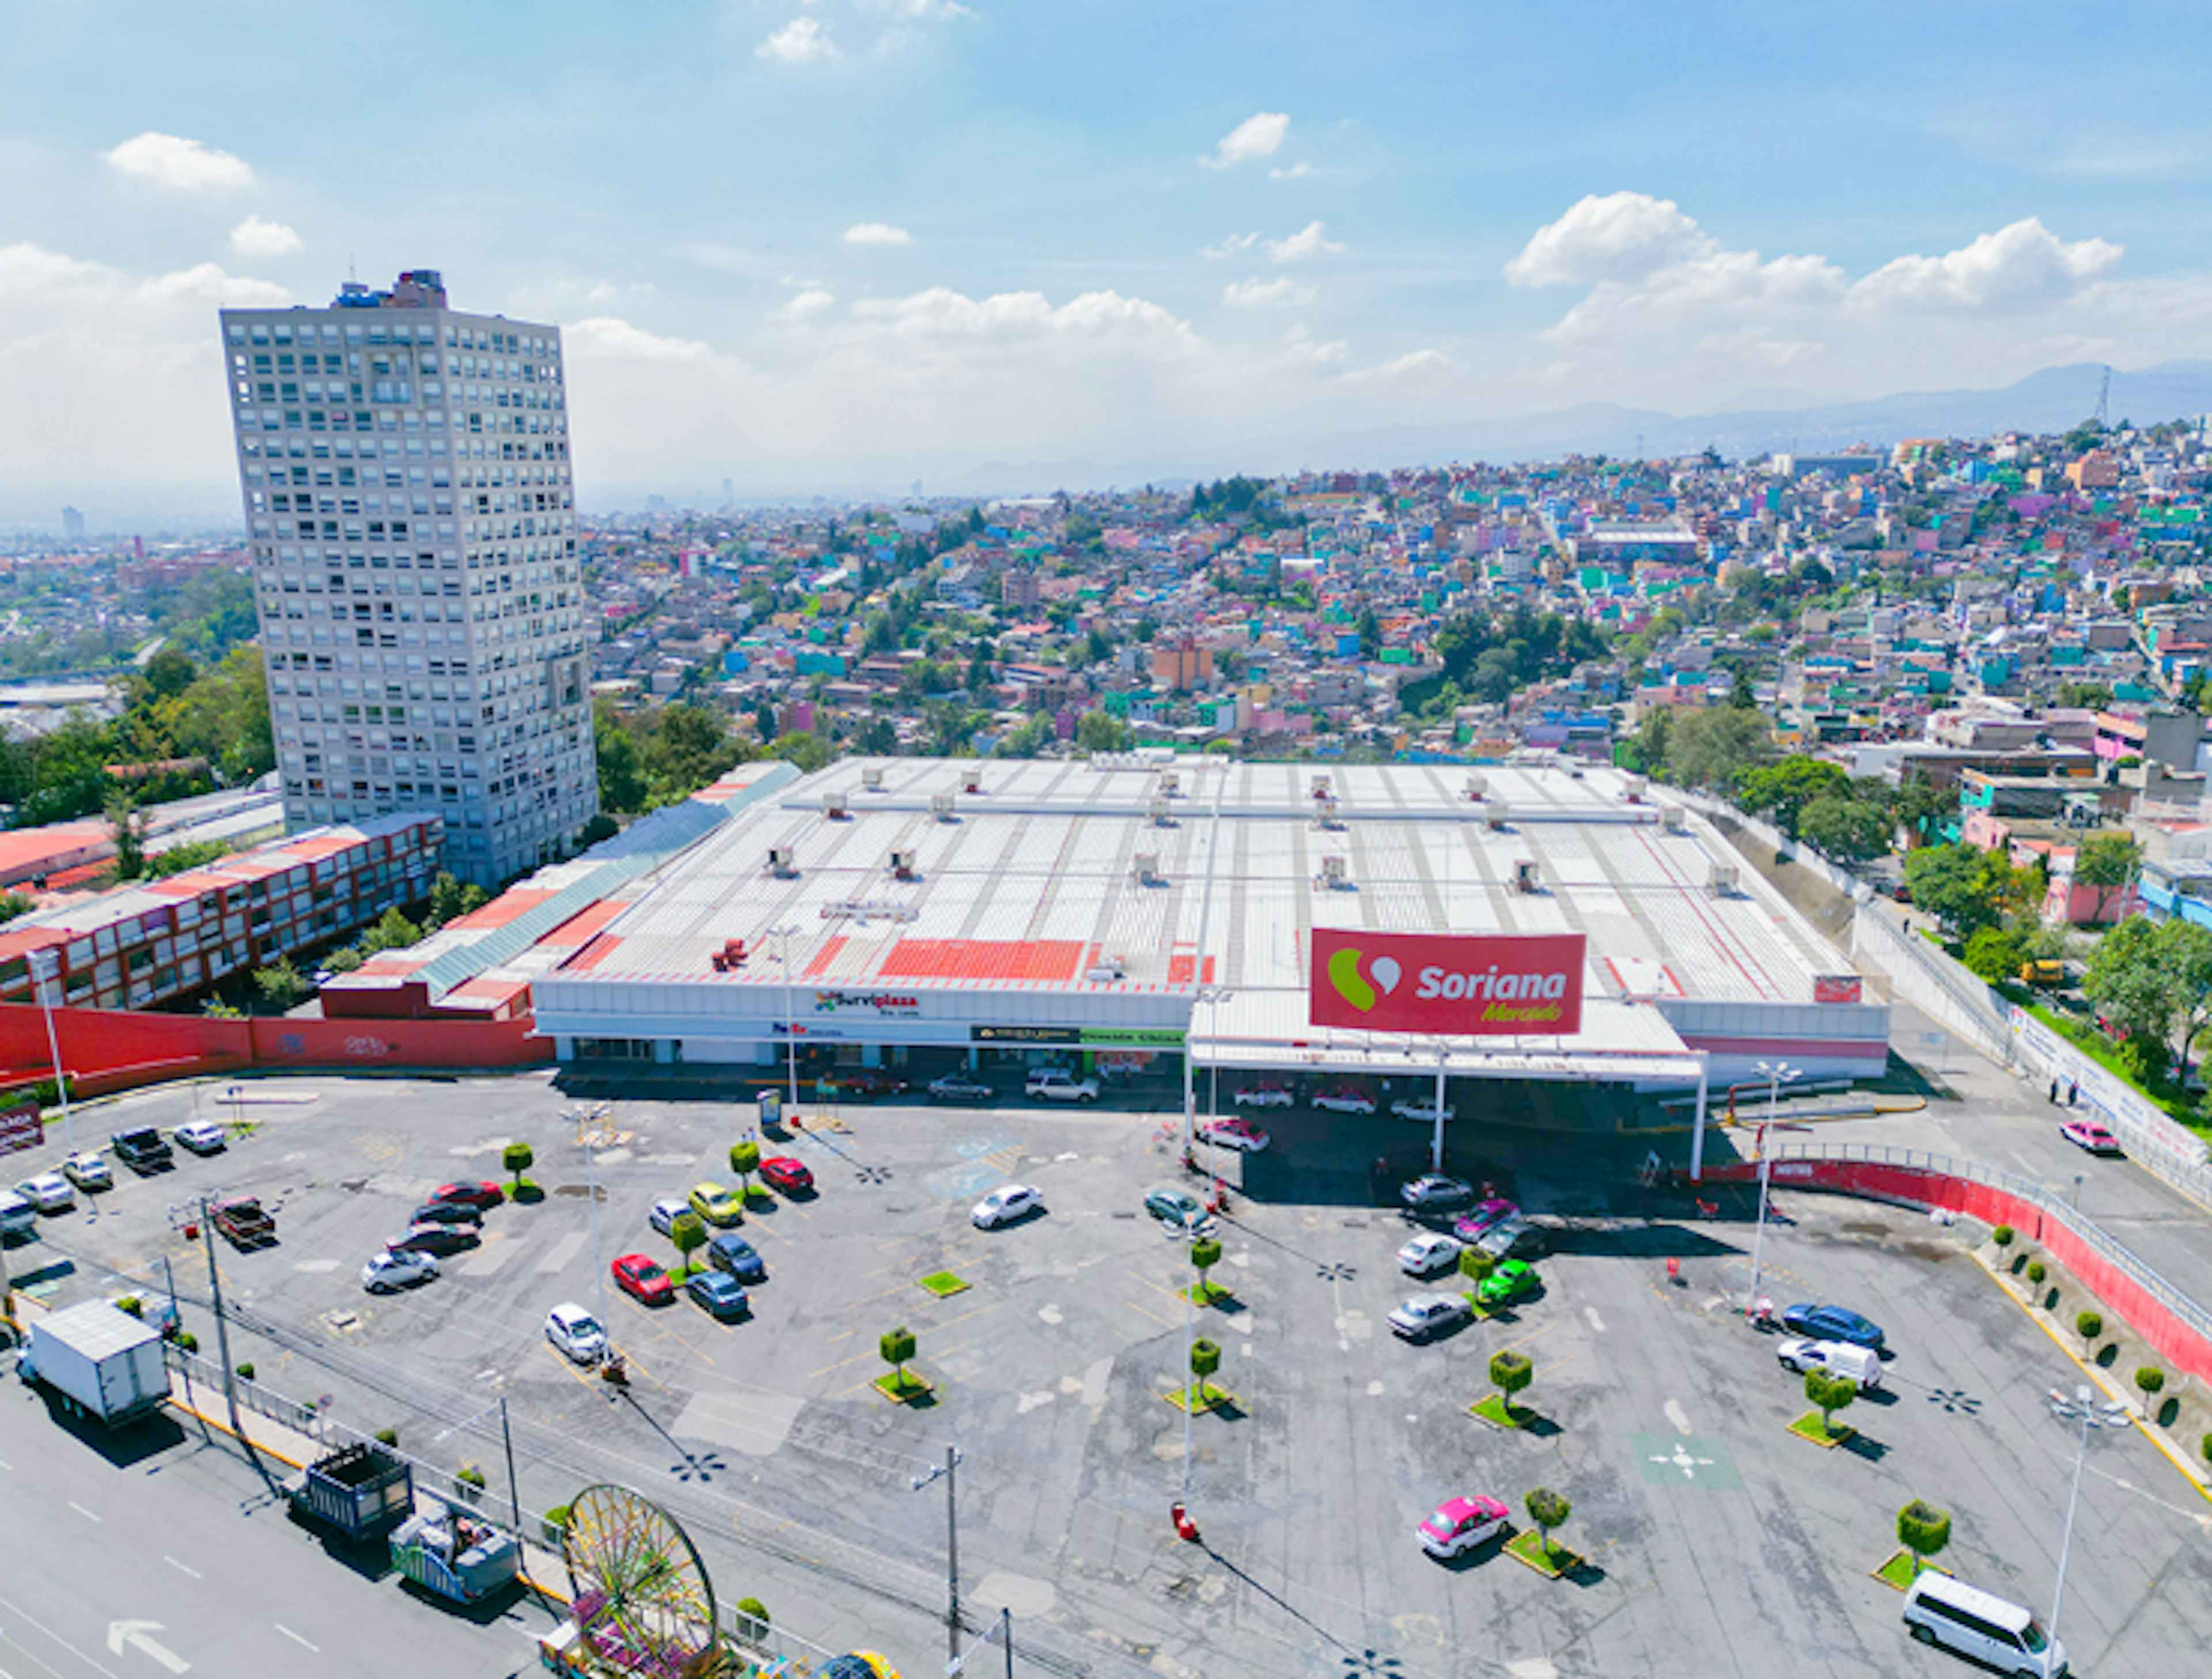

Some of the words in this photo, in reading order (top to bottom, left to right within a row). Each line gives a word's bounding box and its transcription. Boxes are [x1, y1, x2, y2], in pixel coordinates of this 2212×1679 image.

[1415, 964, 1567, 999] Soriana
[1480, 1001, 1563, 1022] Mercado
[772, 1021, 807, 1034] FeEx
